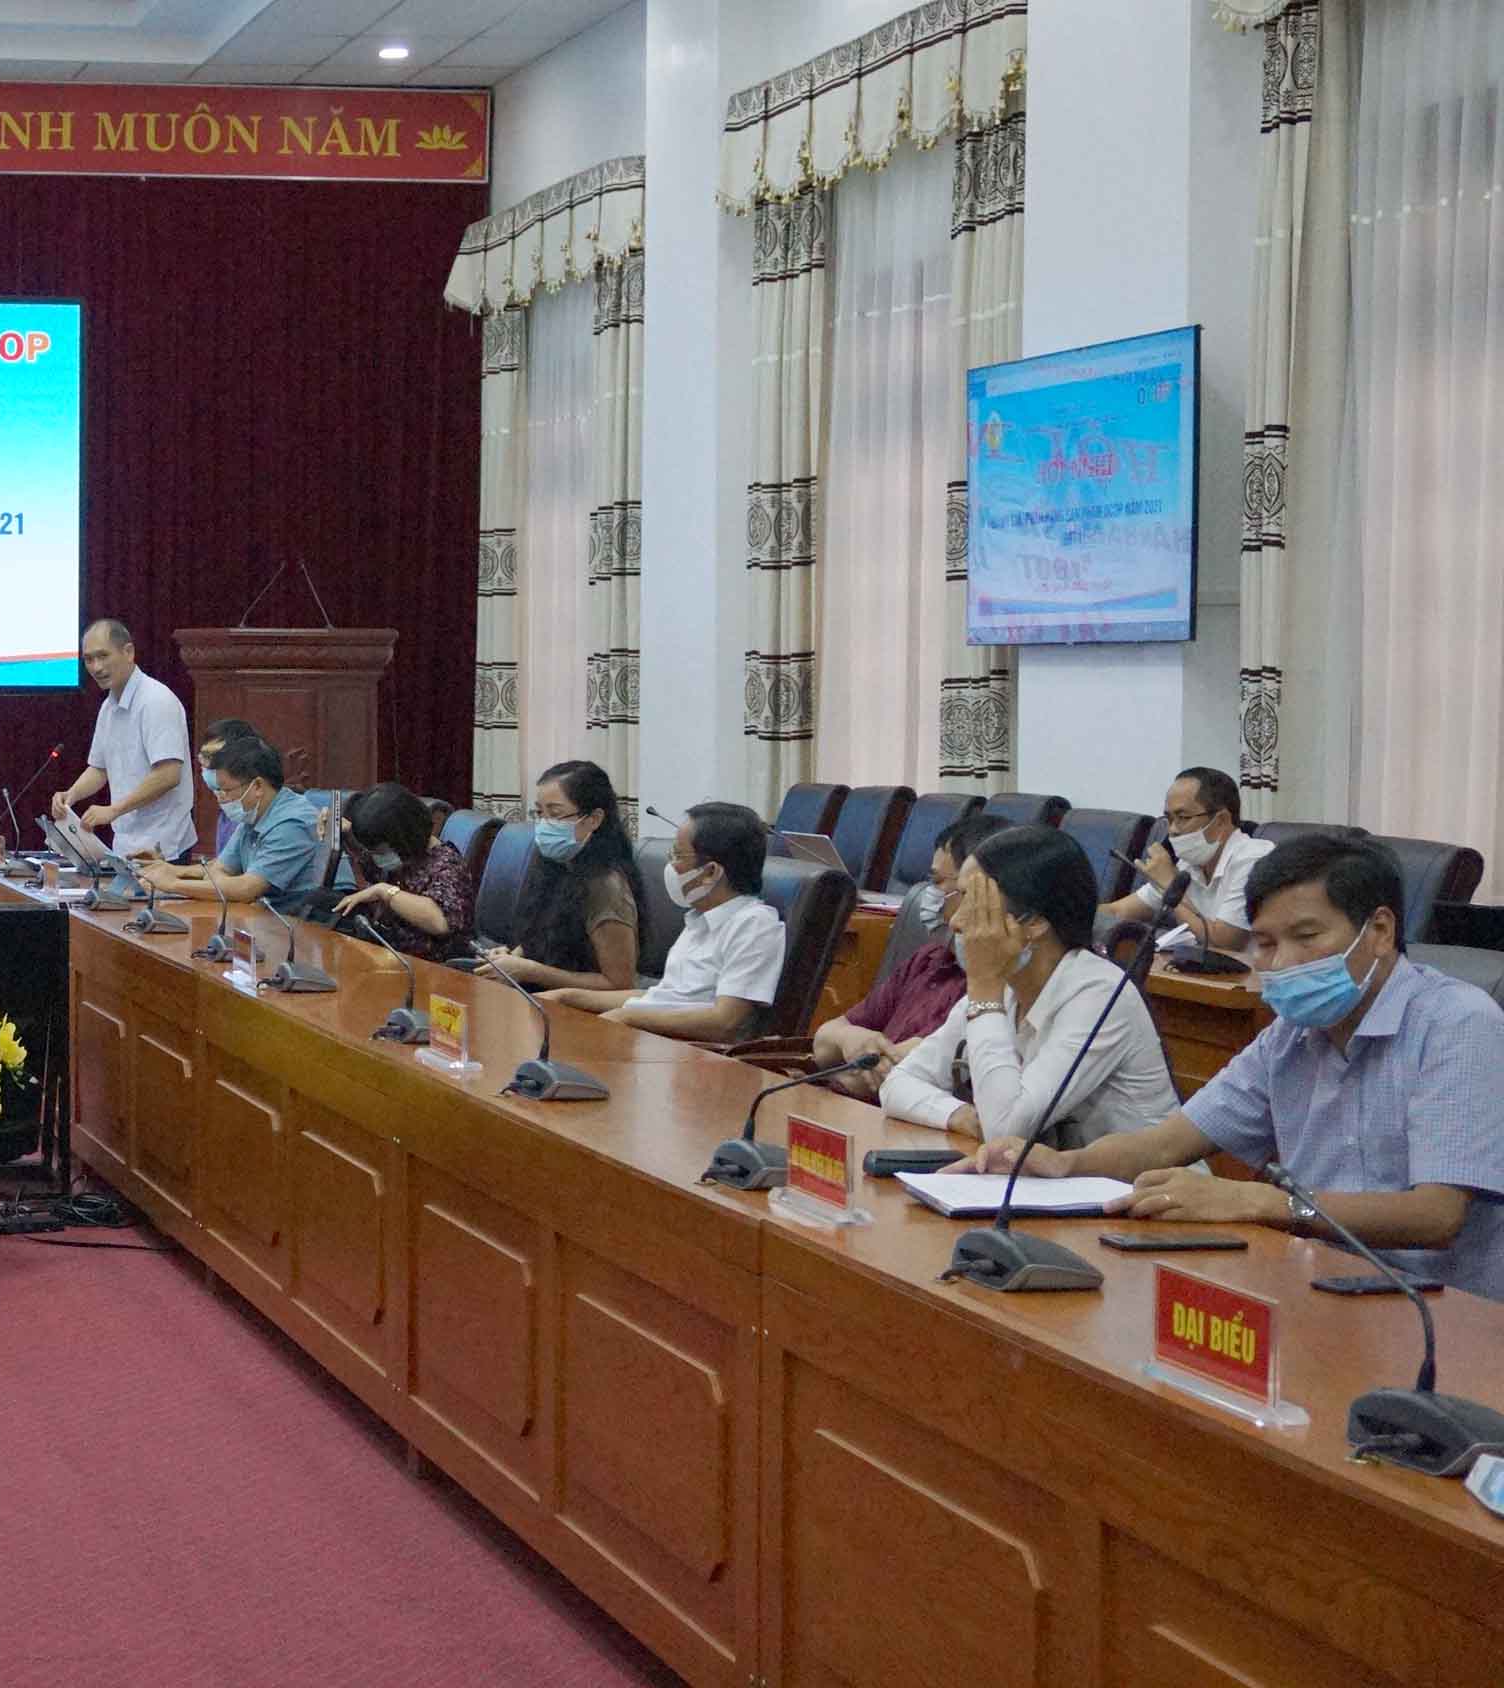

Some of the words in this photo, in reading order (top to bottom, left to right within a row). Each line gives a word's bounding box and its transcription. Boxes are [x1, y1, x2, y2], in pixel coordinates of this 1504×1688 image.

[94, 103, 263, 154] MUÔN
[279, 105, 402, 158] NĂM
[1172, 1301, 1205, 1351] ĐẠI
[1209, 1310, 1256, 1365] BIỂU
